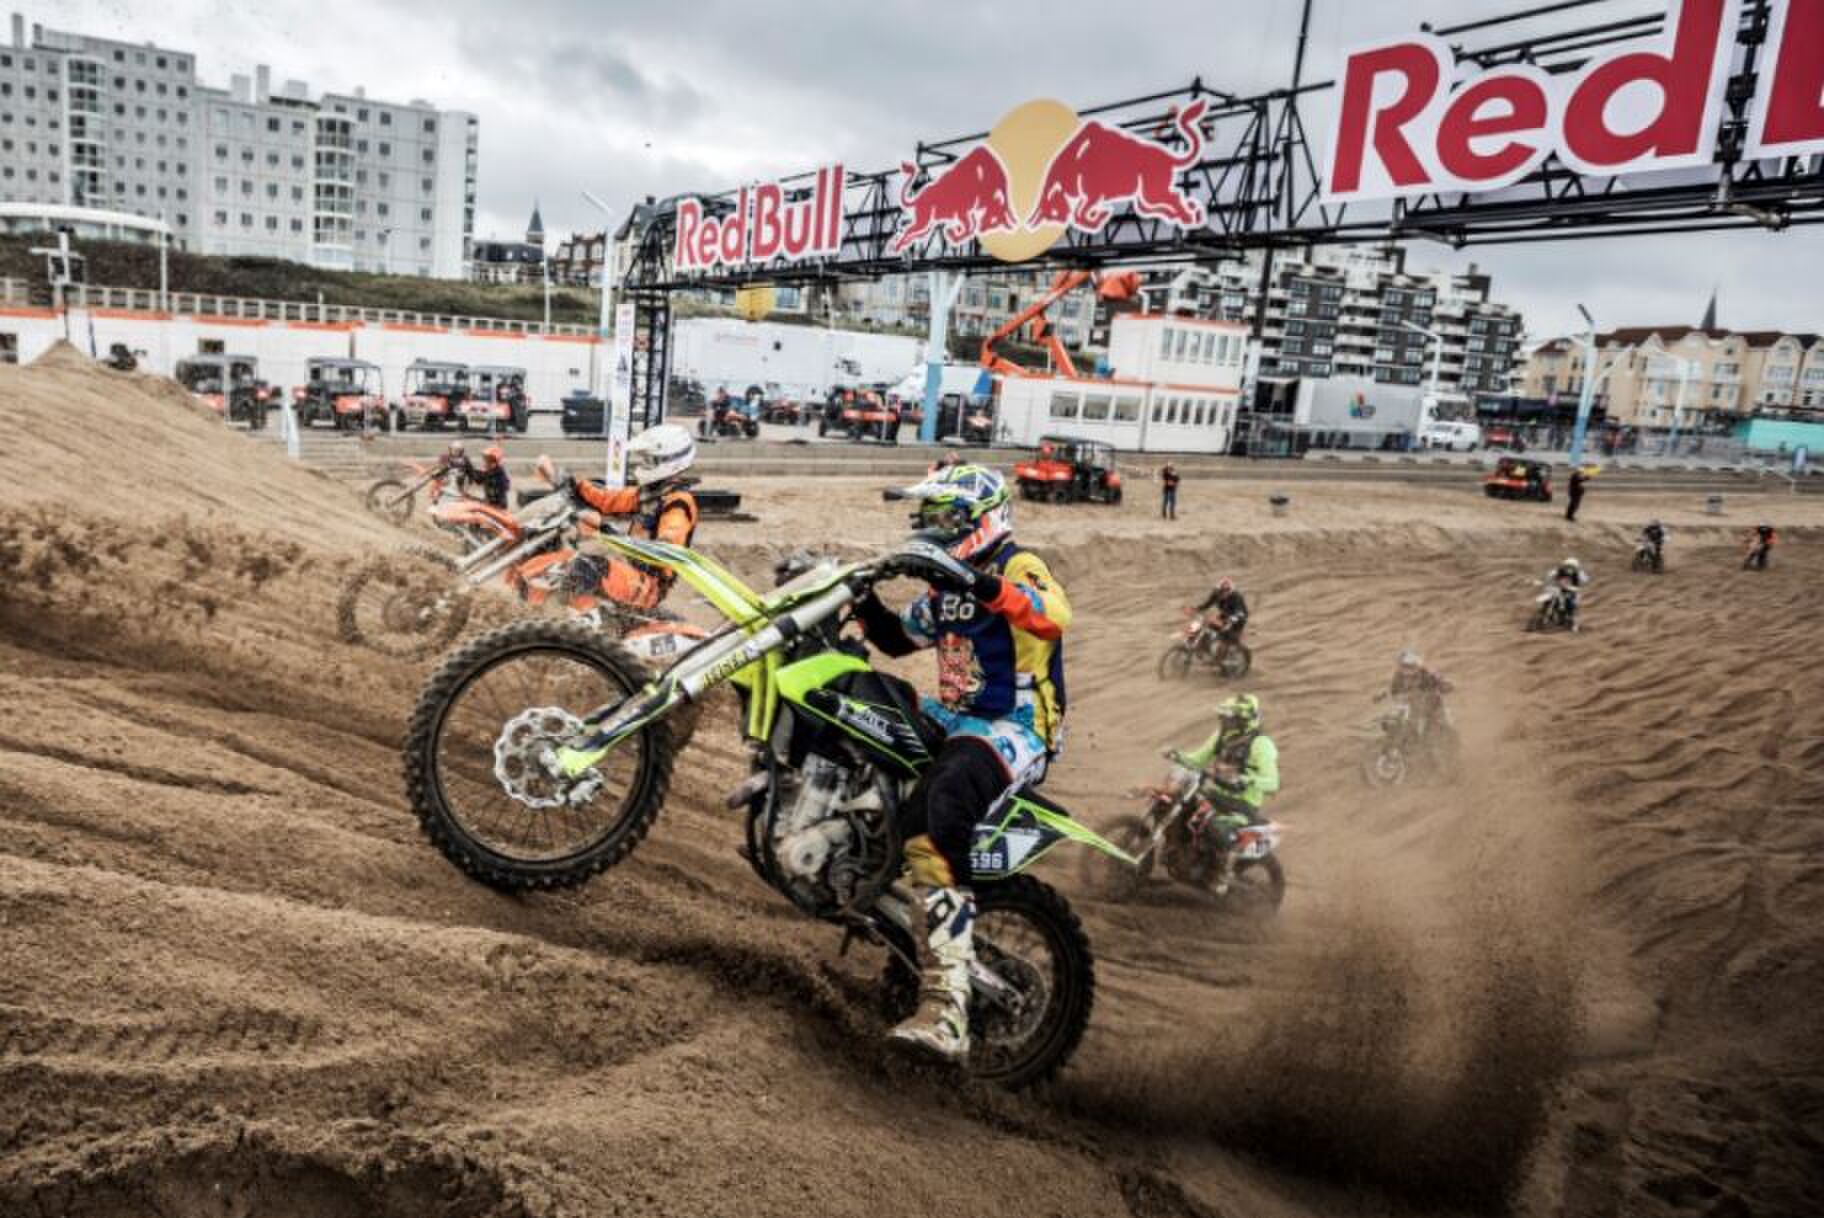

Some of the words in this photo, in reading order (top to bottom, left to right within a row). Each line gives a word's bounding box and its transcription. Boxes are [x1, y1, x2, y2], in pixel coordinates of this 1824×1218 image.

[1331, 0, 1725, 193] Red
[676, 186, 748, 267] Red
[751, 165, 843, 257] Bull
